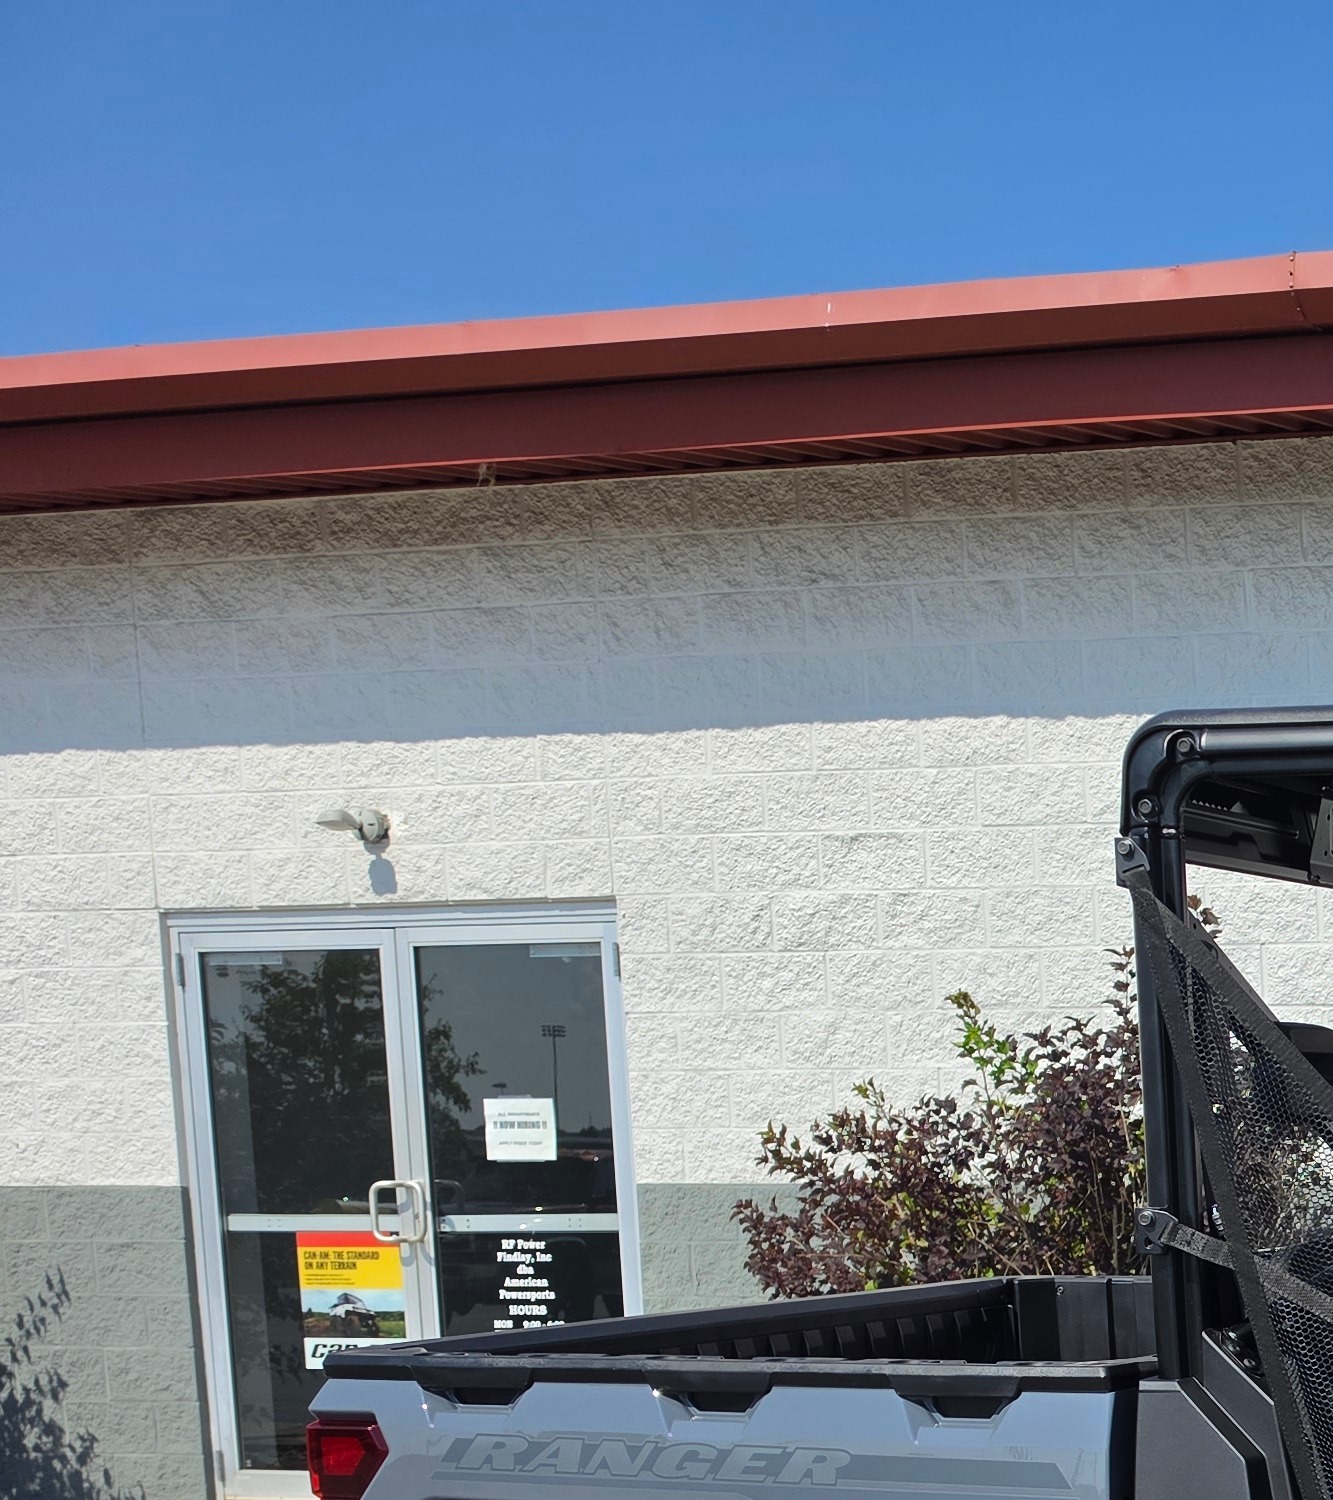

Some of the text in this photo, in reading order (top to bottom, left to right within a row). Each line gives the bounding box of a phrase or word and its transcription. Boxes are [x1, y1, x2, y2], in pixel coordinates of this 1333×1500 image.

[499, 1121, 516, 1129] NOW
[517, 1121, 541, 1129] HIRING
[517, 1239, 546, 1249] Power
[332, 1251, 345, 1260] THE
[346, 1251, 380, 1260] STANDARD
[496, 1252, 535, 1264] Findlay,
[304, 1261, 357, 1270] ON ANY TERRAIN
[516, 1264, 535, 1274] dba
[504, 1277, 549, 1287] American
[499, 1289, 556, 1302] Powersports
[509, 1305, 547, 1315] HOURS
[493, 1320, 513, 1328] MON
[454, 1433, 852, 1487] RANGER
